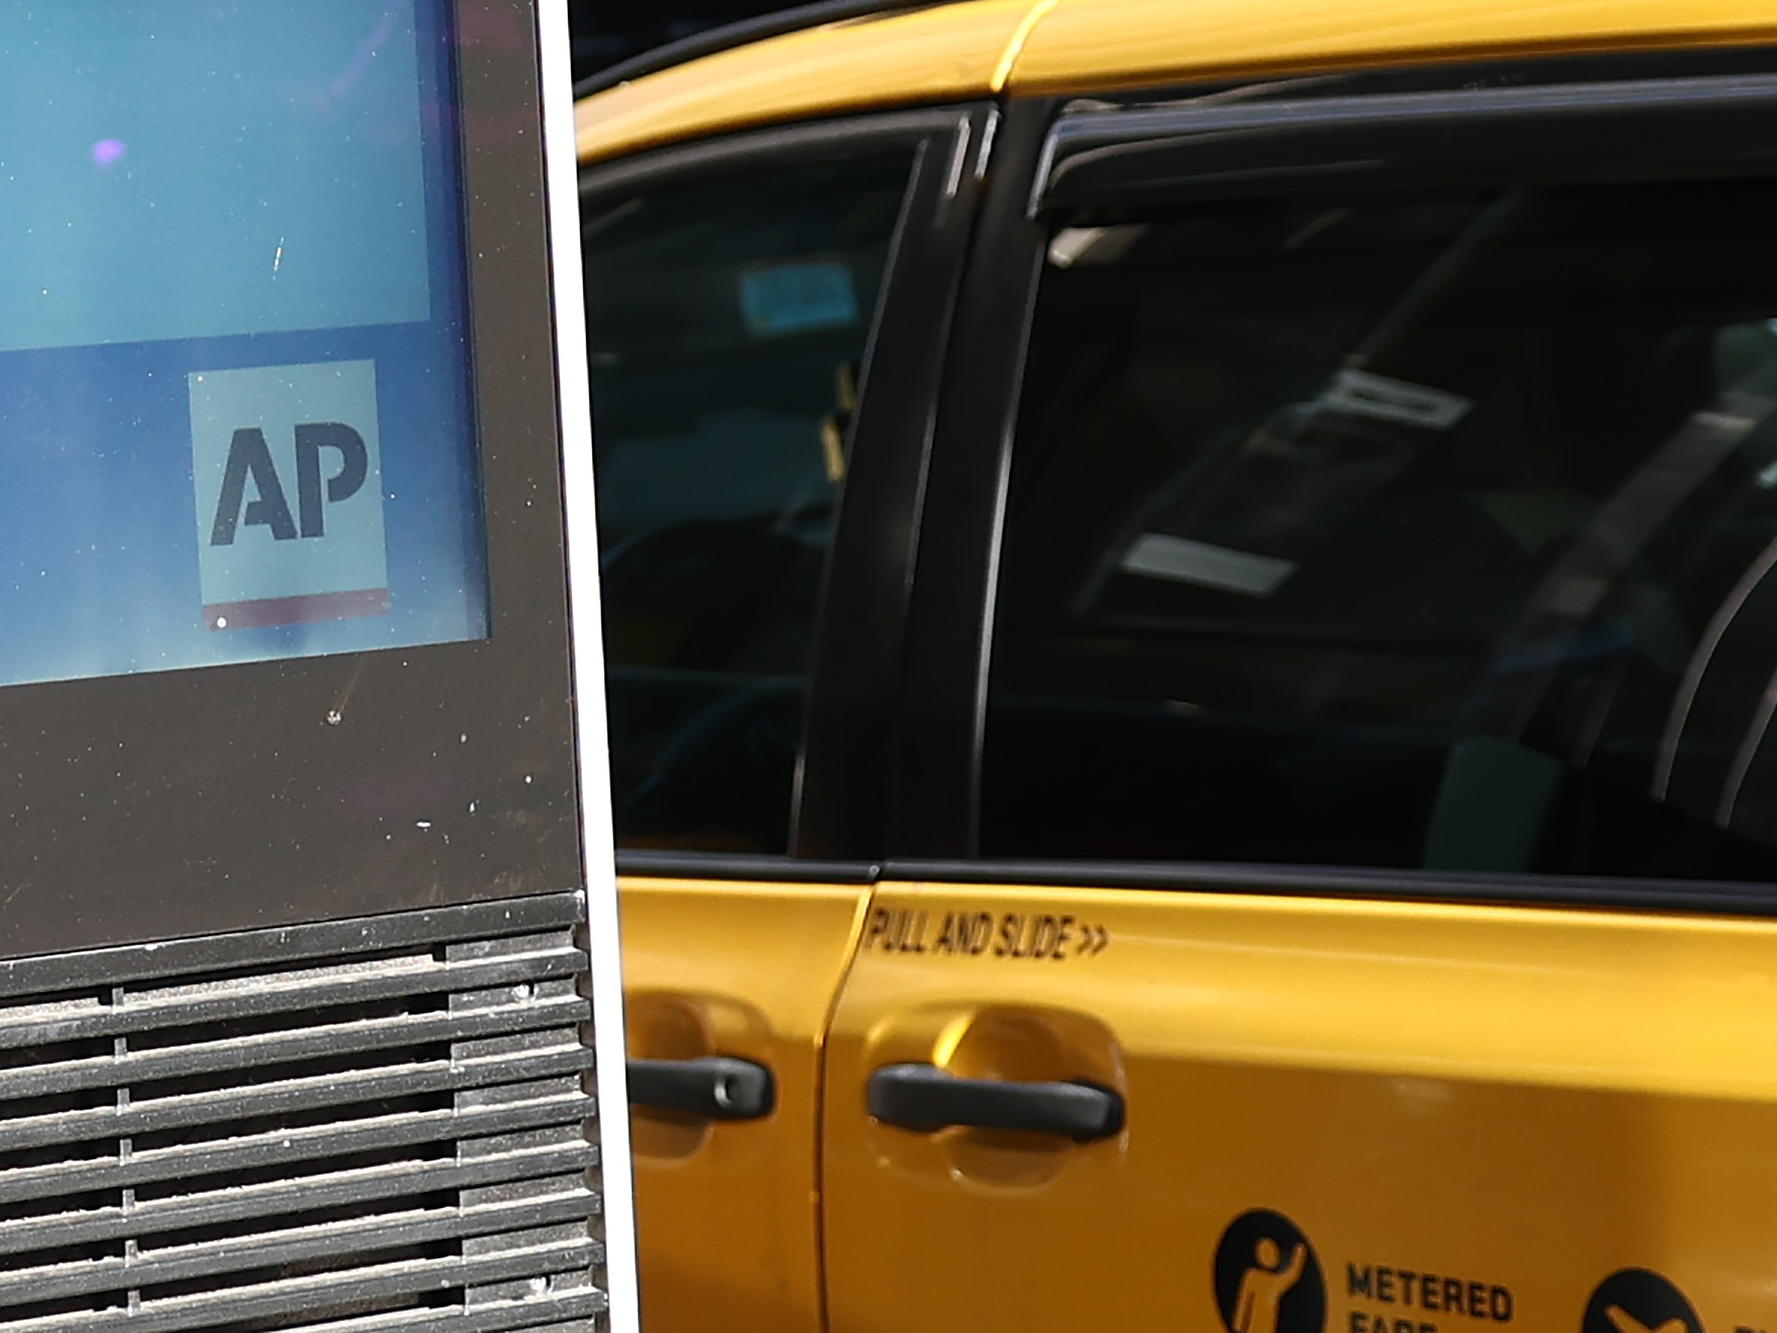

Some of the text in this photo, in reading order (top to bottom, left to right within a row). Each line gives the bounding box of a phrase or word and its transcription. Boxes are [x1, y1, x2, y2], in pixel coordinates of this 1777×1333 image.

[210, 421, 368, 547] AP
[865, 908, 1076, 961] PULL AND SLIDE
[1346, 1262, 1513, 1322] METERED
